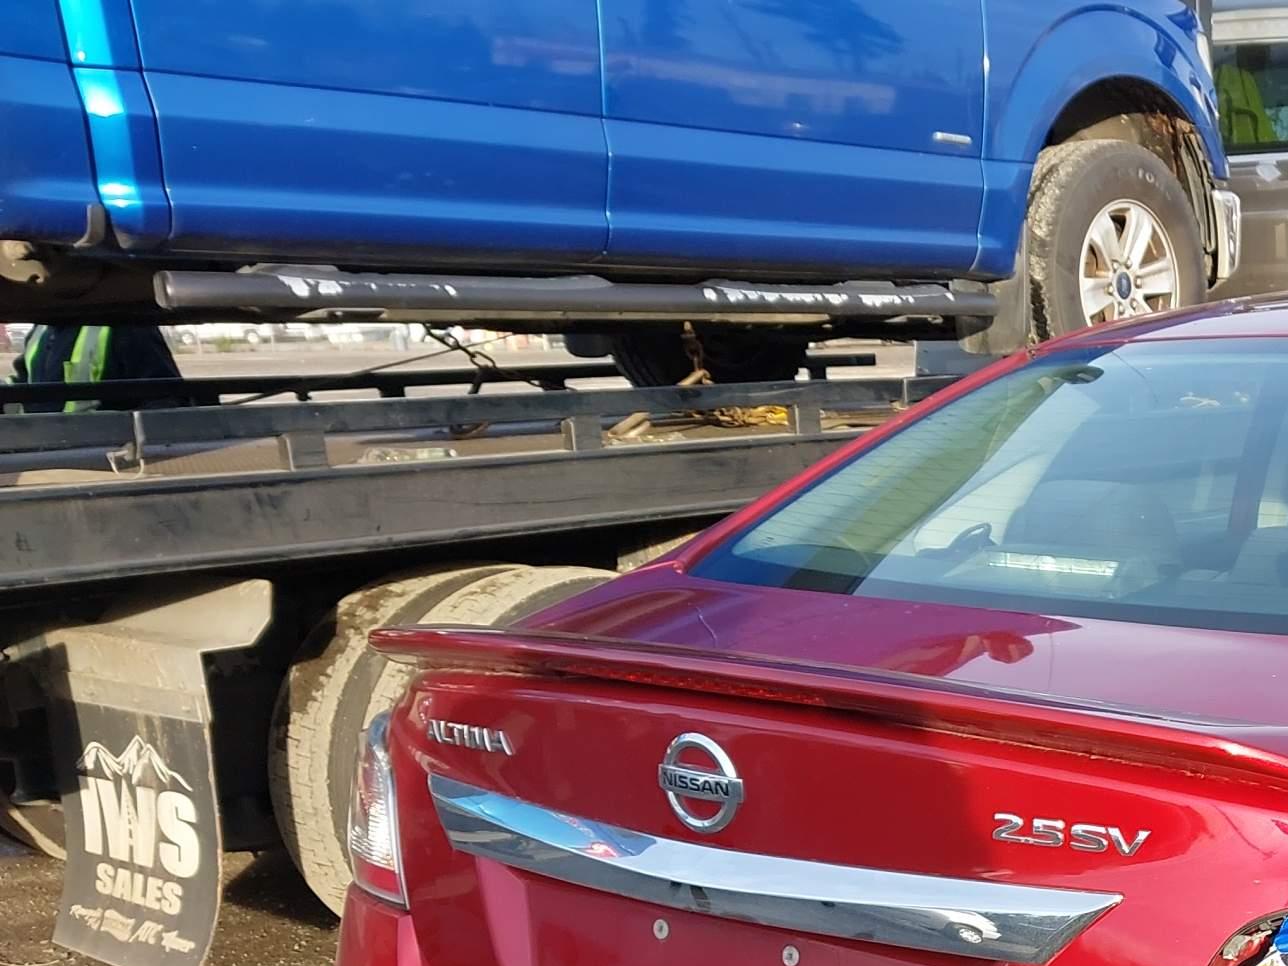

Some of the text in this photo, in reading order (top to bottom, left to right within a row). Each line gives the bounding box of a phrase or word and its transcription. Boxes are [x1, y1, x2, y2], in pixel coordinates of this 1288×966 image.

[427, 719, 513, 756] ALTIMA
[662, 771, 730, 797] NISSAN
[95, 862, 183, 916] SALES
